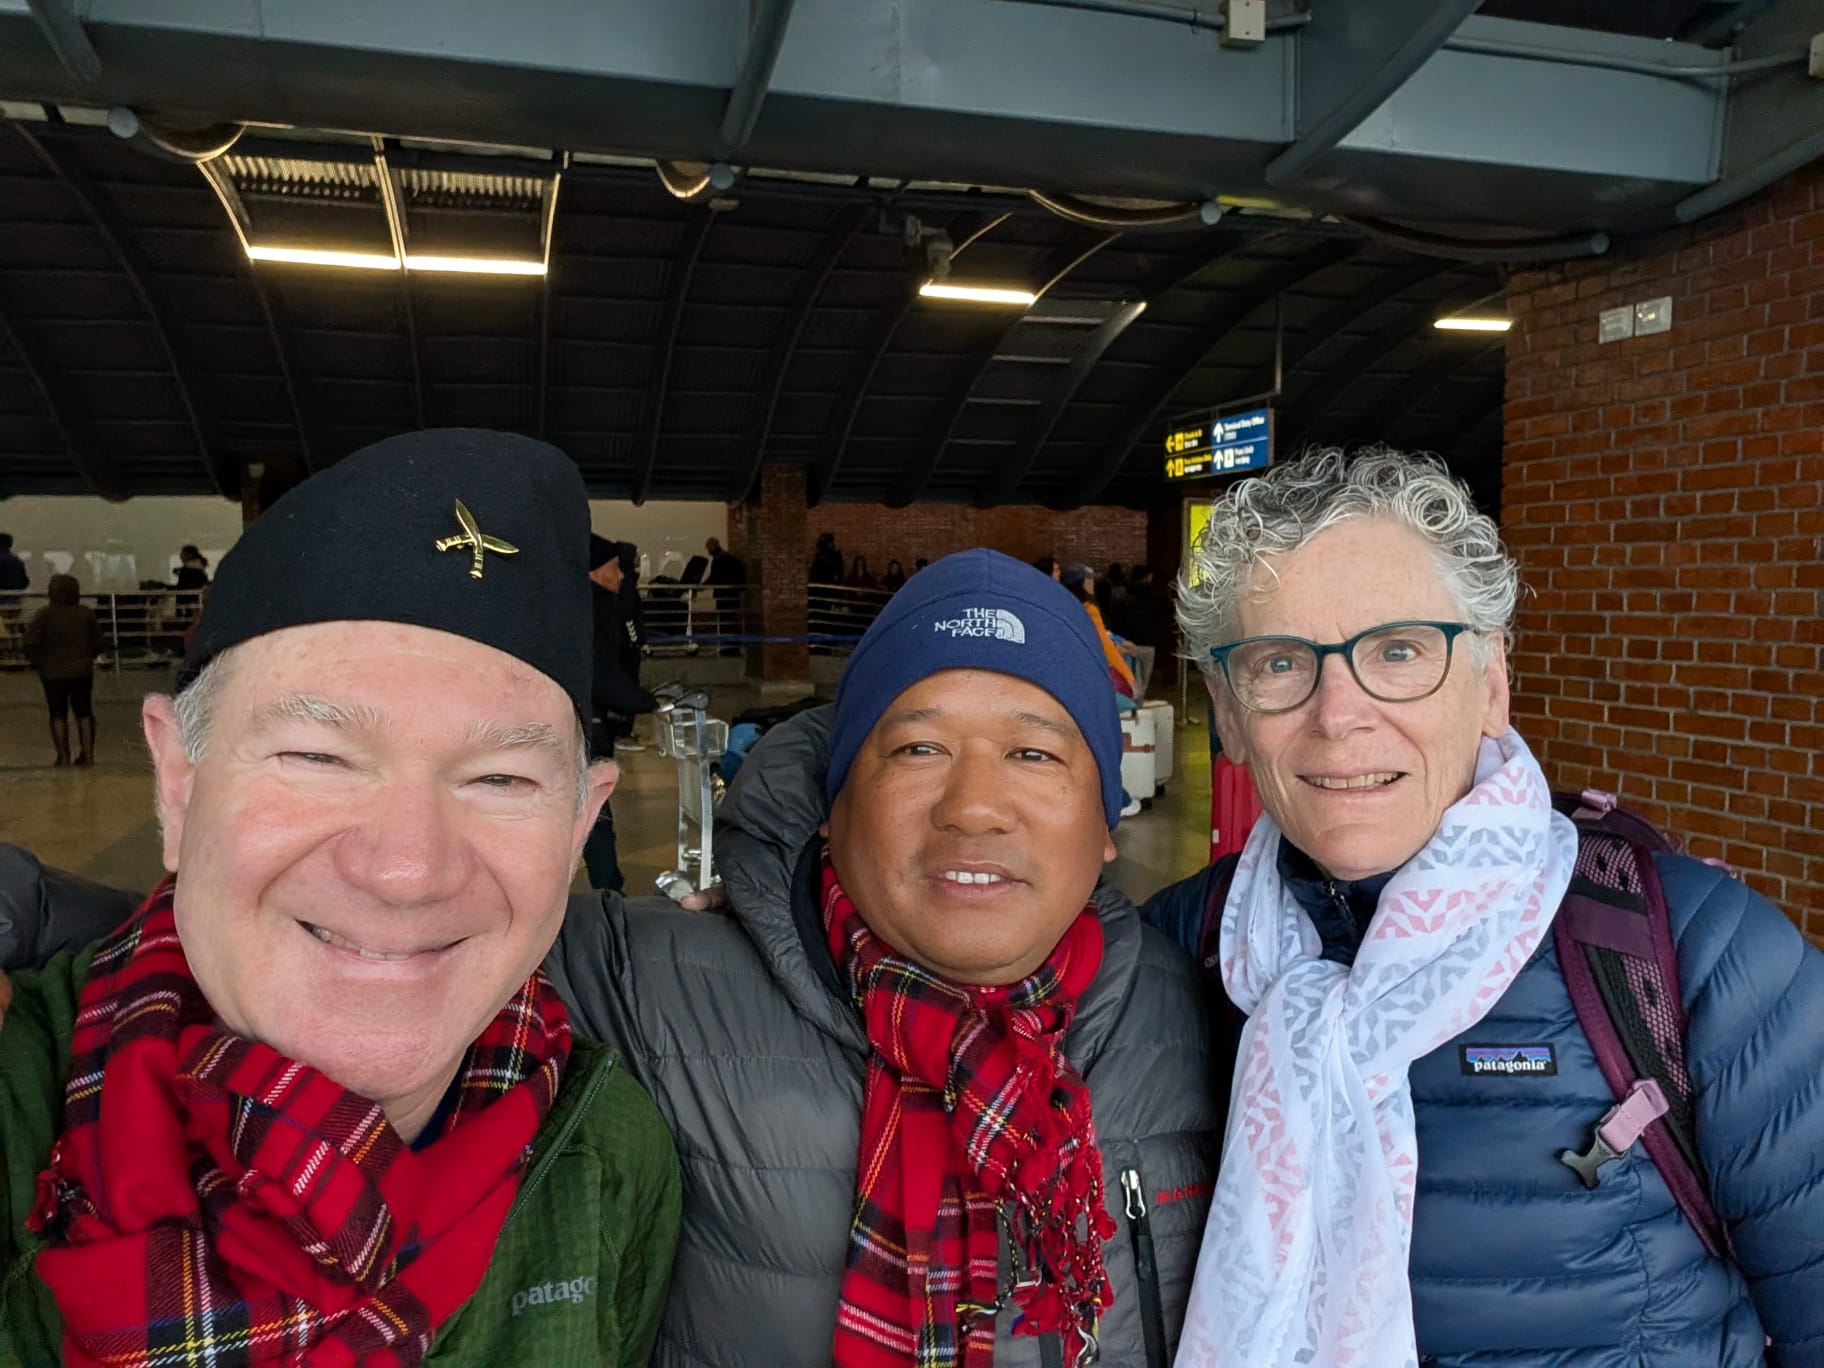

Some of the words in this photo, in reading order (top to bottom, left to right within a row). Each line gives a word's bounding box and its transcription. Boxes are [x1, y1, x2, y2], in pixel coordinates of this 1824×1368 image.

[962, 607, 997, 619] THE
[934, 617, 996, 632] NORTH
[951, 627, 996, 637] FACE
[1473, 1060, 1546, 1073] patagonia
[512, 1276, 598, 1317] patago
